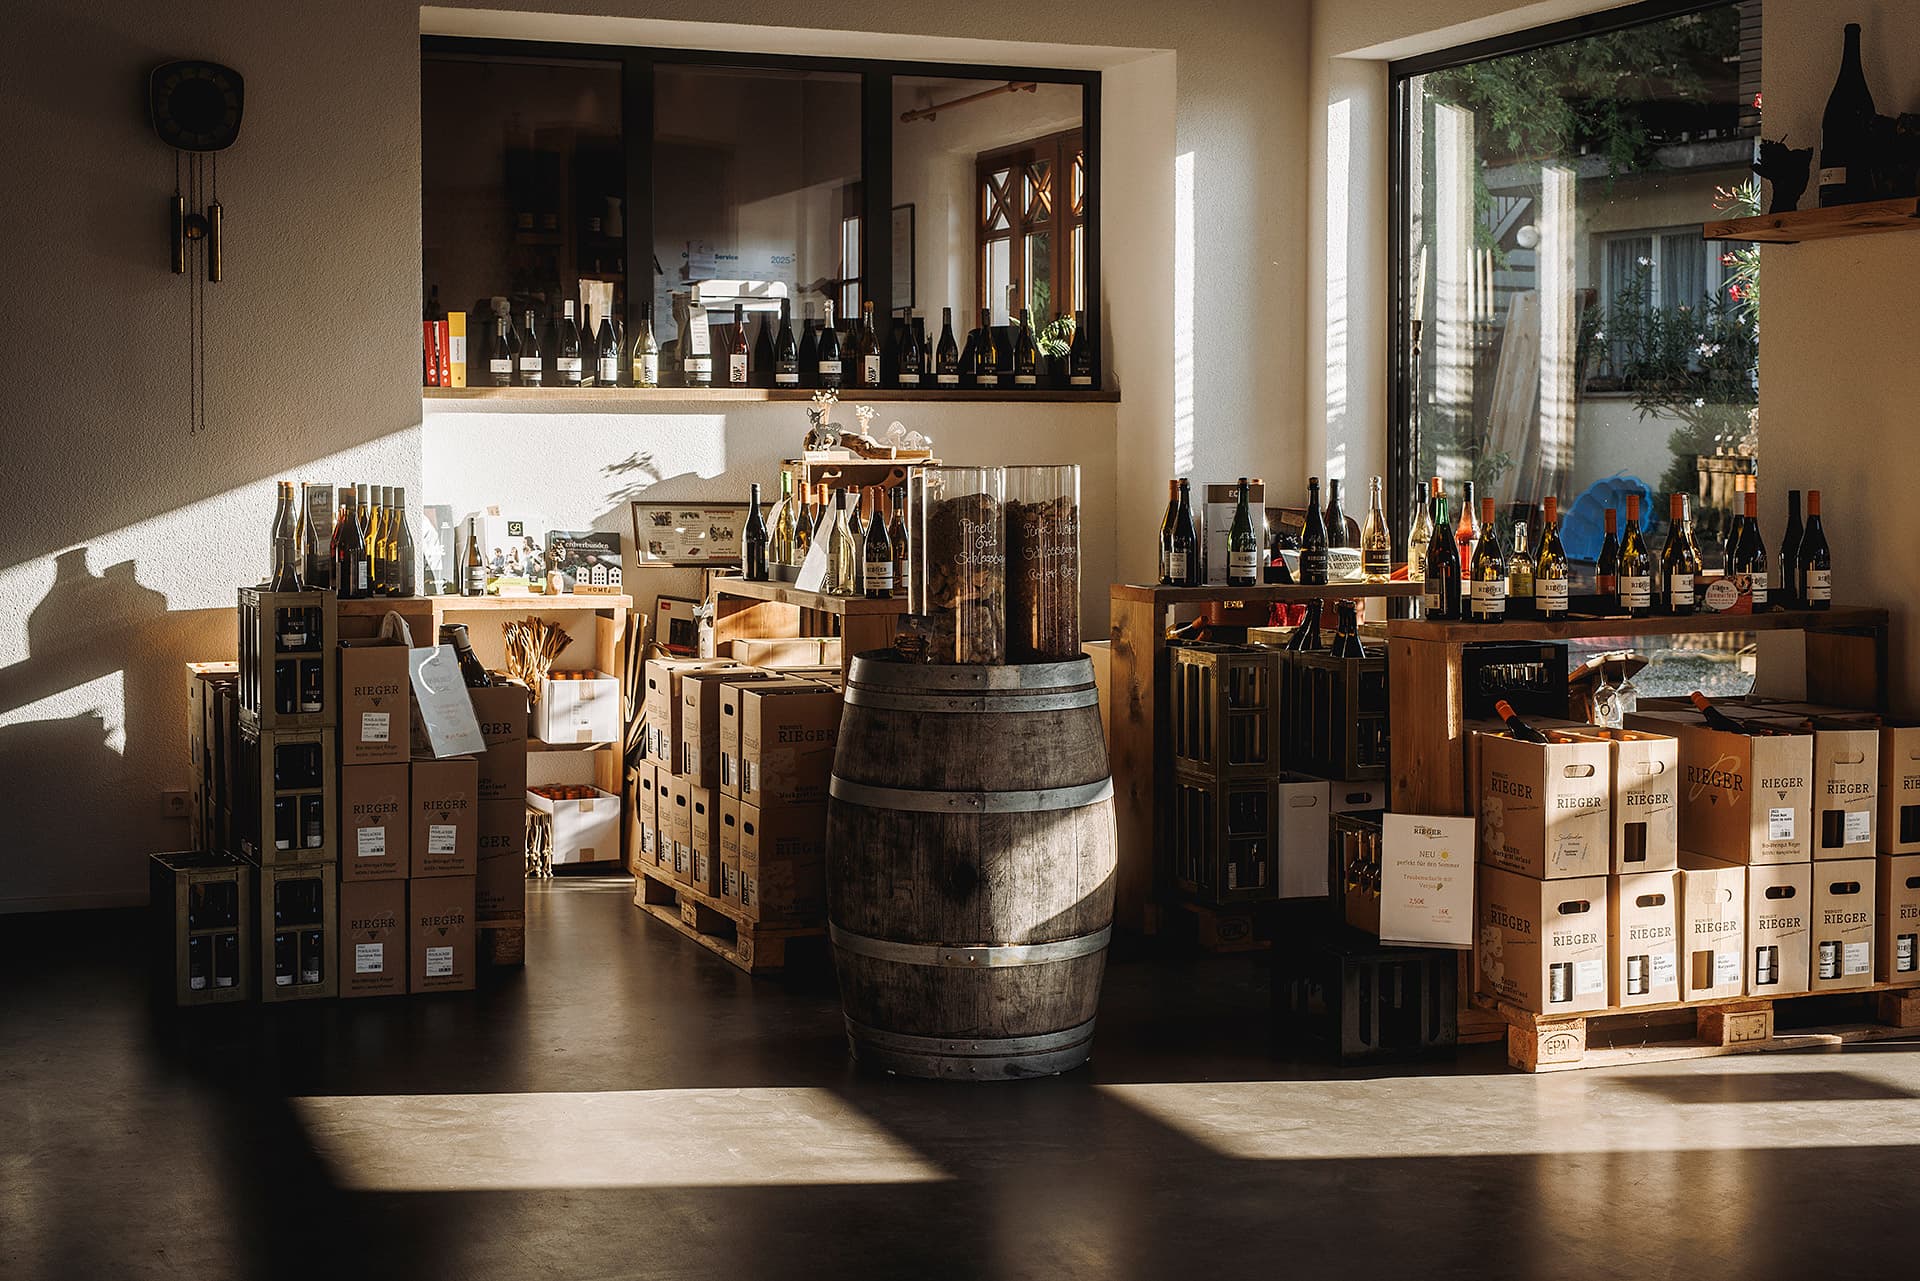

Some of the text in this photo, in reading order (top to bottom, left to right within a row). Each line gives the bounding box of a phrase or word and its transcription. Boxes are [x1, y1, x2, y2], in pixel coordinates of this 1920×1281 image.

[771, 256, 791, 264] 2025
[975, 536, 997, 550] Gris
[354, 685, 399, 696] RIEGER
[481, 723, 512, 734] GER
[778, 730, 834, 743] RIEGER
[1687, 765, 1743, 791] RIEGER
[1761, 777, 1803, 788] RIEGER
[1491, 778, 1532, 799] RIEGER
[1827, 783, 1869, 794] RIEGER
[423, 799, 468, 810] RIEGER
[1557, 797, 1601, 809] RIEGER
[1627, 794, 1669, 806] RIEGER
[353, 802, 399, 814] RIEGER
[480, 836, 511, 847] GER
[351, 917, 396, 930] RIEGER
[421, 914, 465, 927] RIEGER
[1490, 910, 1531, 934] RIEGER
[1759, 918, 1801, 929] RIEGER
[1824, 913, 1867, 924] RIEGER
[1630, 927, 1671, 940] RIEGER
[1695, 921, 1737, 934] RIEGER
[1553, 934, 1598, 947] RIEGER
